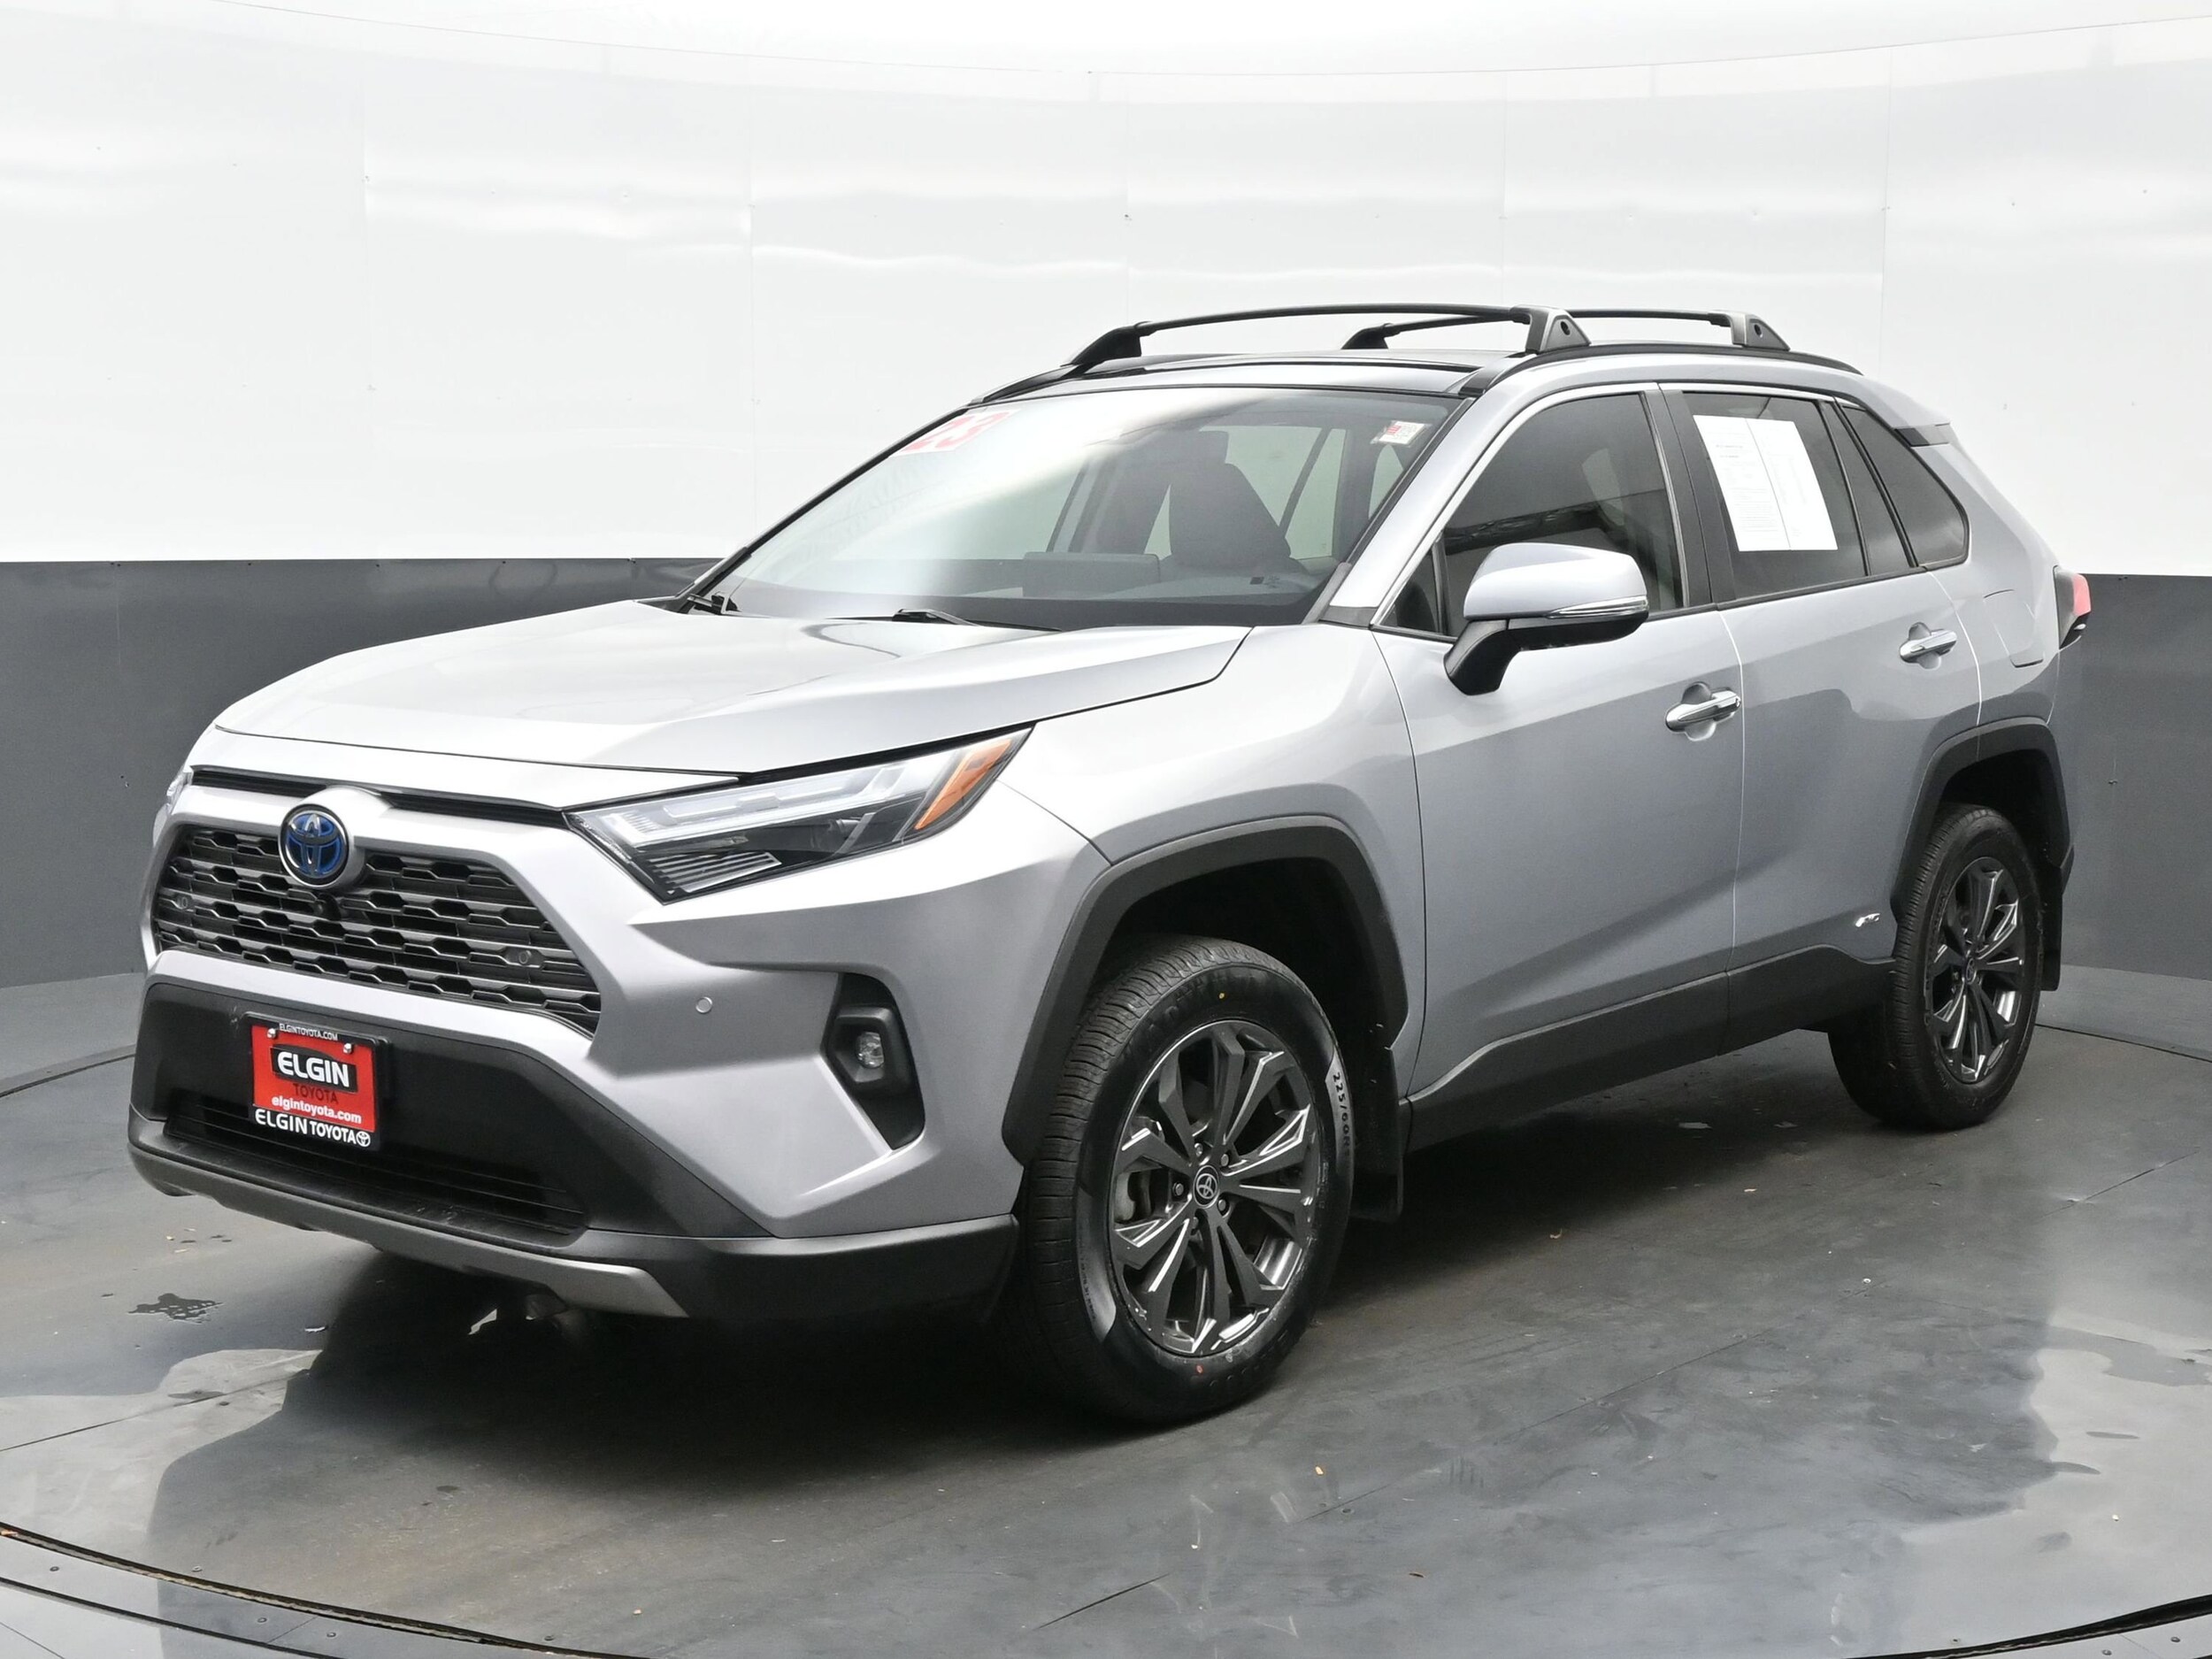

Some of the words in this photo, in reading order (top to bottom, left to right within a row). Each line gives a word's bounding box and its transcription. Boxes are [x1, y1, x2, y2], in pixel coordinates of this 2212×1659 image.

[279, 1023, 338, 1041] ELGINTOYOTA.COM
[277, 1051, 349, 1087] ELGIN
[294, 1083, 339, 1103] TOYOTA
[272, 1095, 362, 1124] elgintoyota.com
[255, 1109, 308, 1134] ELGIN
[310, 1121, 357, 1144] TOYOTA
